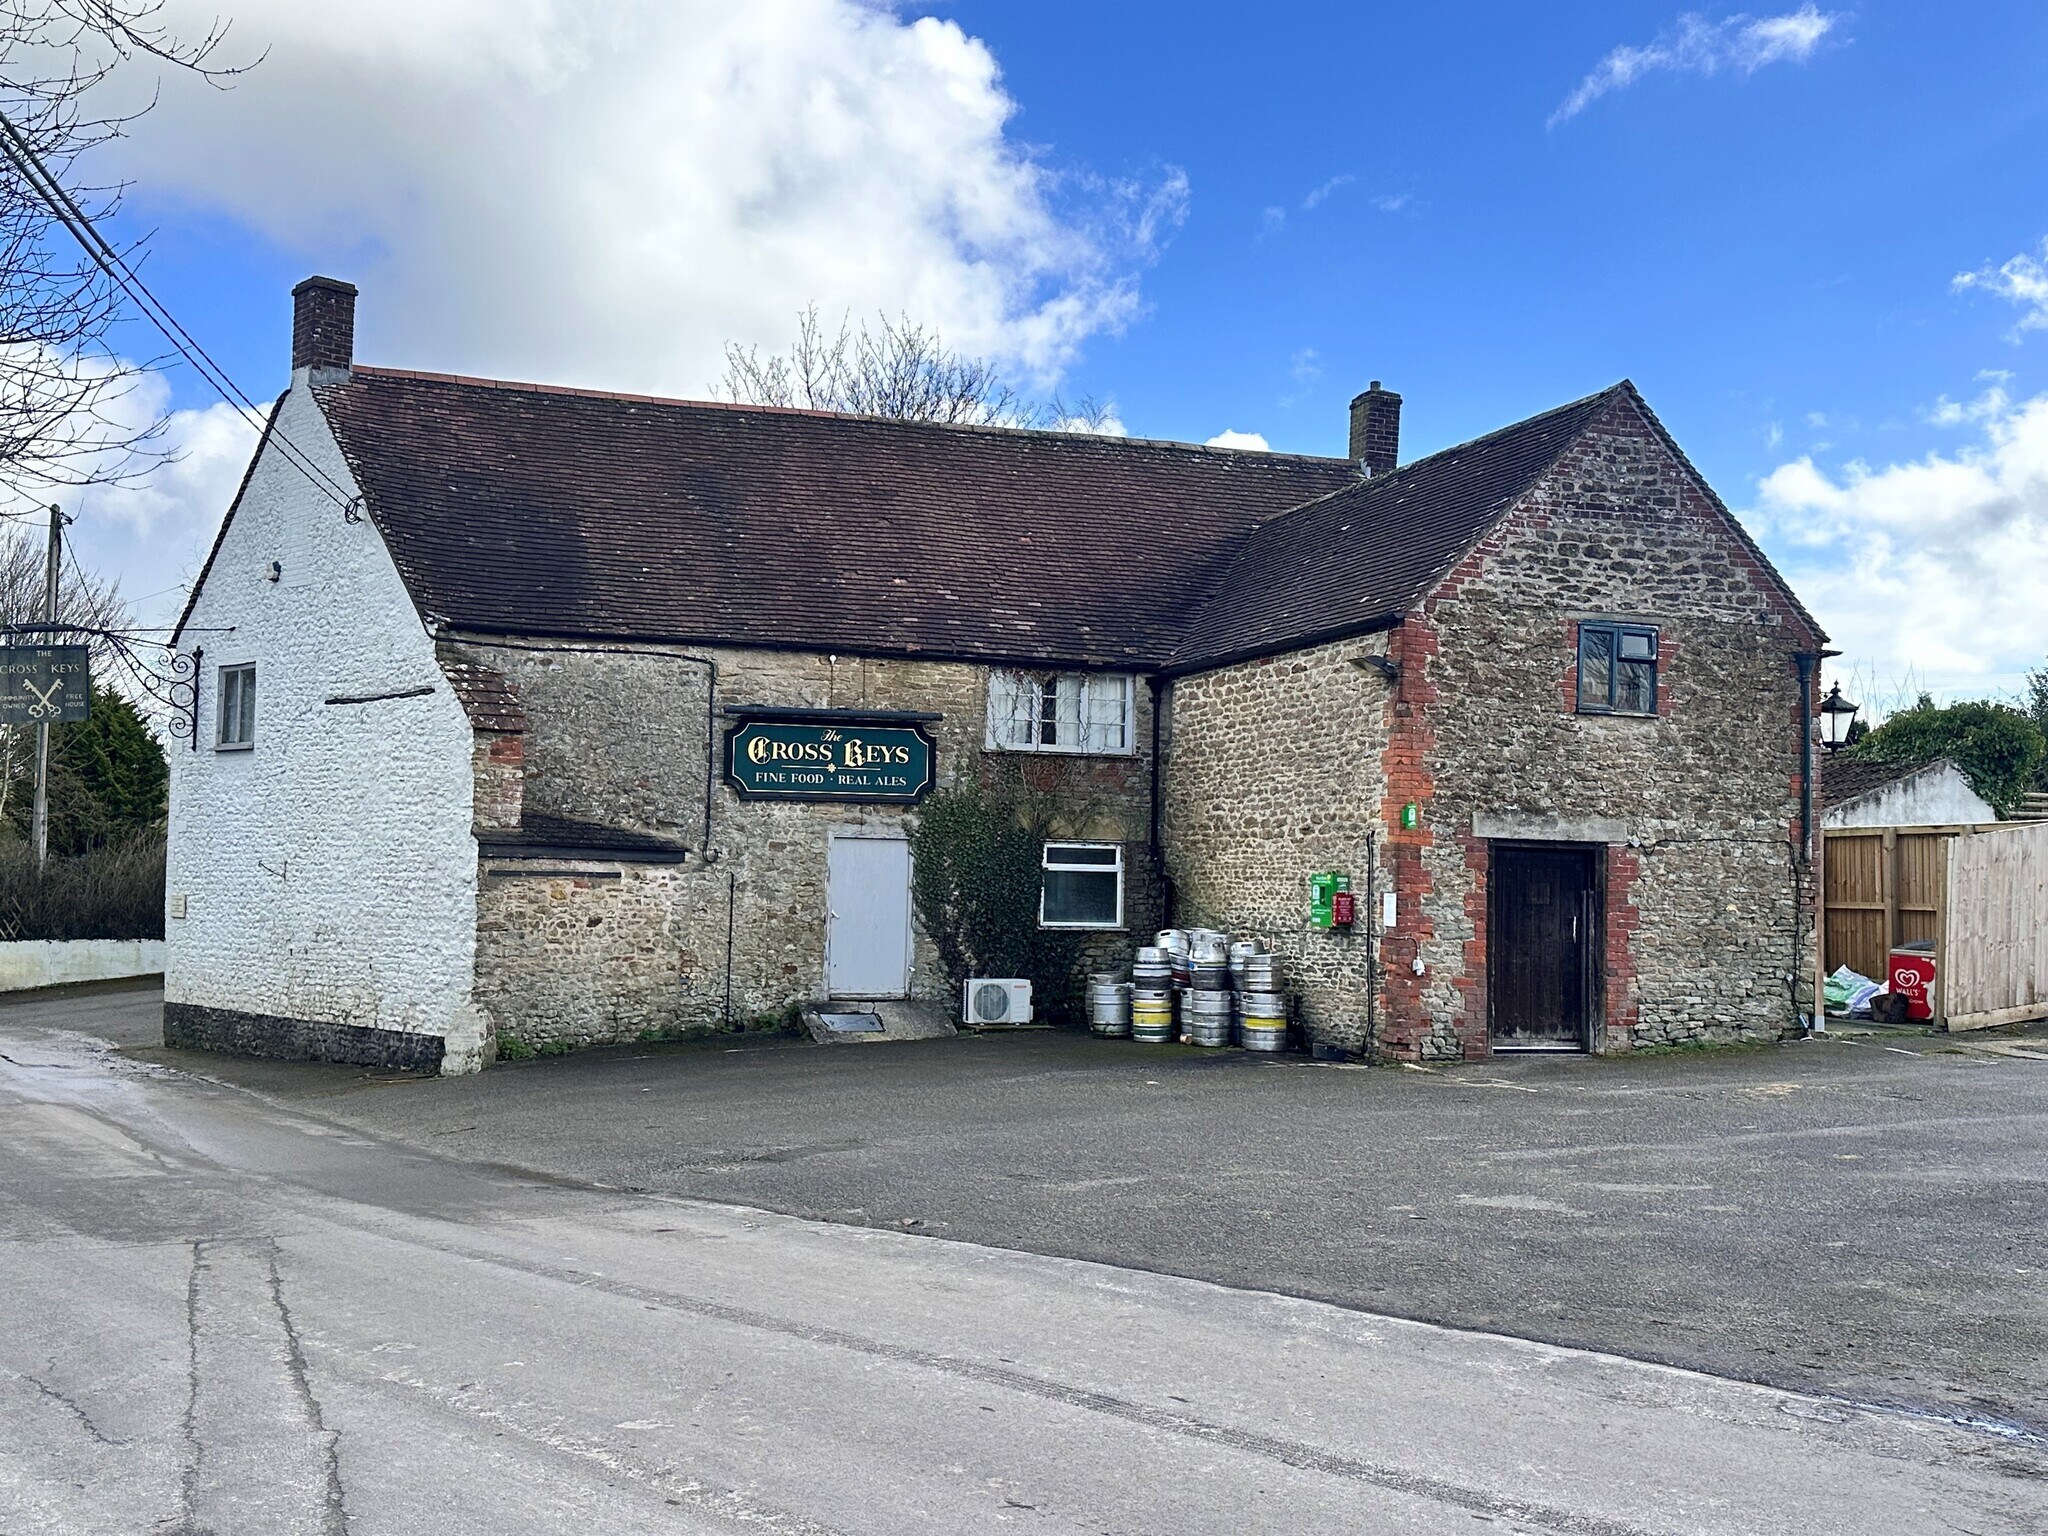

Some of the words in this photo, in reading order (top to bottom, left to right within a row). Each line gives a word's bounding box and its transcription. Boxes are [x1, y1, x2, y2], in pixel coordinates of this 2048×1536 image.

[0, 665, 37, 674] CROSS
[51, 664, 80, 673] KEYS
[820, 729, 843, 742] The
[747, 735, 833, 765] CROSS
[843, 738, 910, 767] KEYS
[755, 771, 787, 783] FINE
[791, 773, 824, 784] FOOD
[838, 775, 871, 786] REAL
[874, 776, 907, 787] ALES
[1896, 988, 1919, 997] WALL'S
